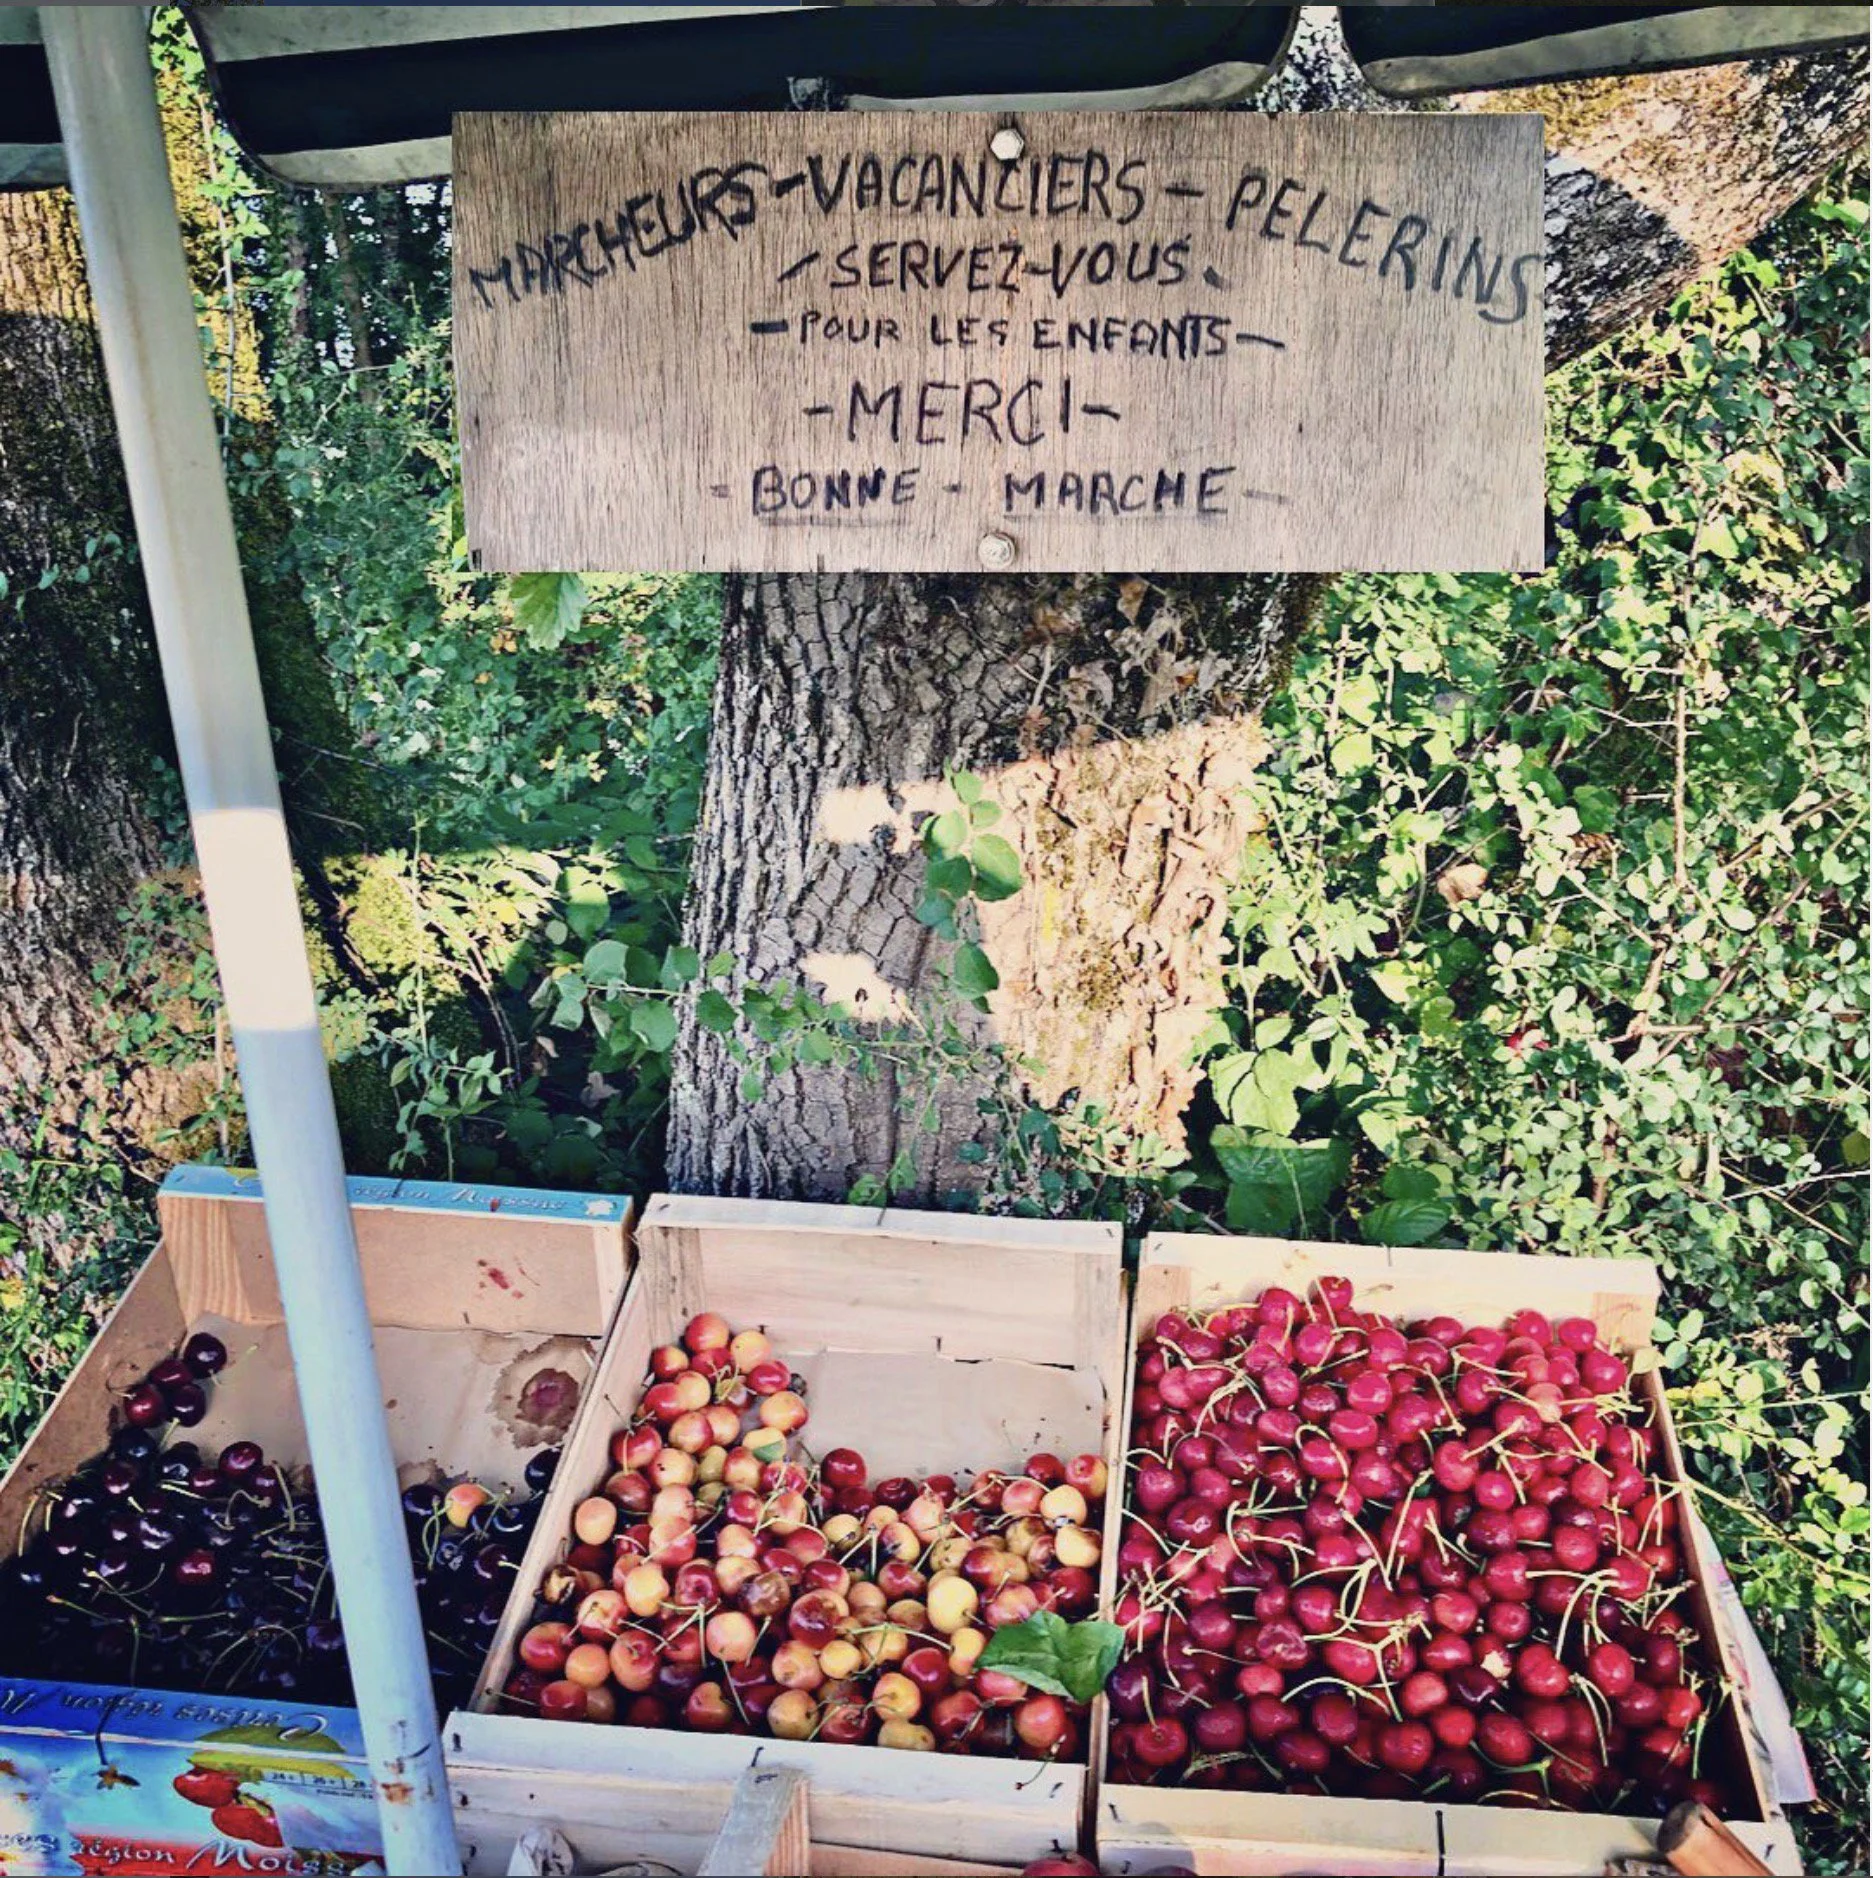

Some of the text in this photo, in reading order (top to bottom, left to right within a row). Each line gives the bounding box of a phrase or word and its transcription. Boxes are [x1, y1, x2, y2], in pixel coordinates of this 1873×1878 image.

[1226, 173, 1543, 325] PELERINS
[930, 315, 1008, 349] LES
[750, 463, 922, 518] BONNE
[1002, 465, 1237, 517] MARCHE
